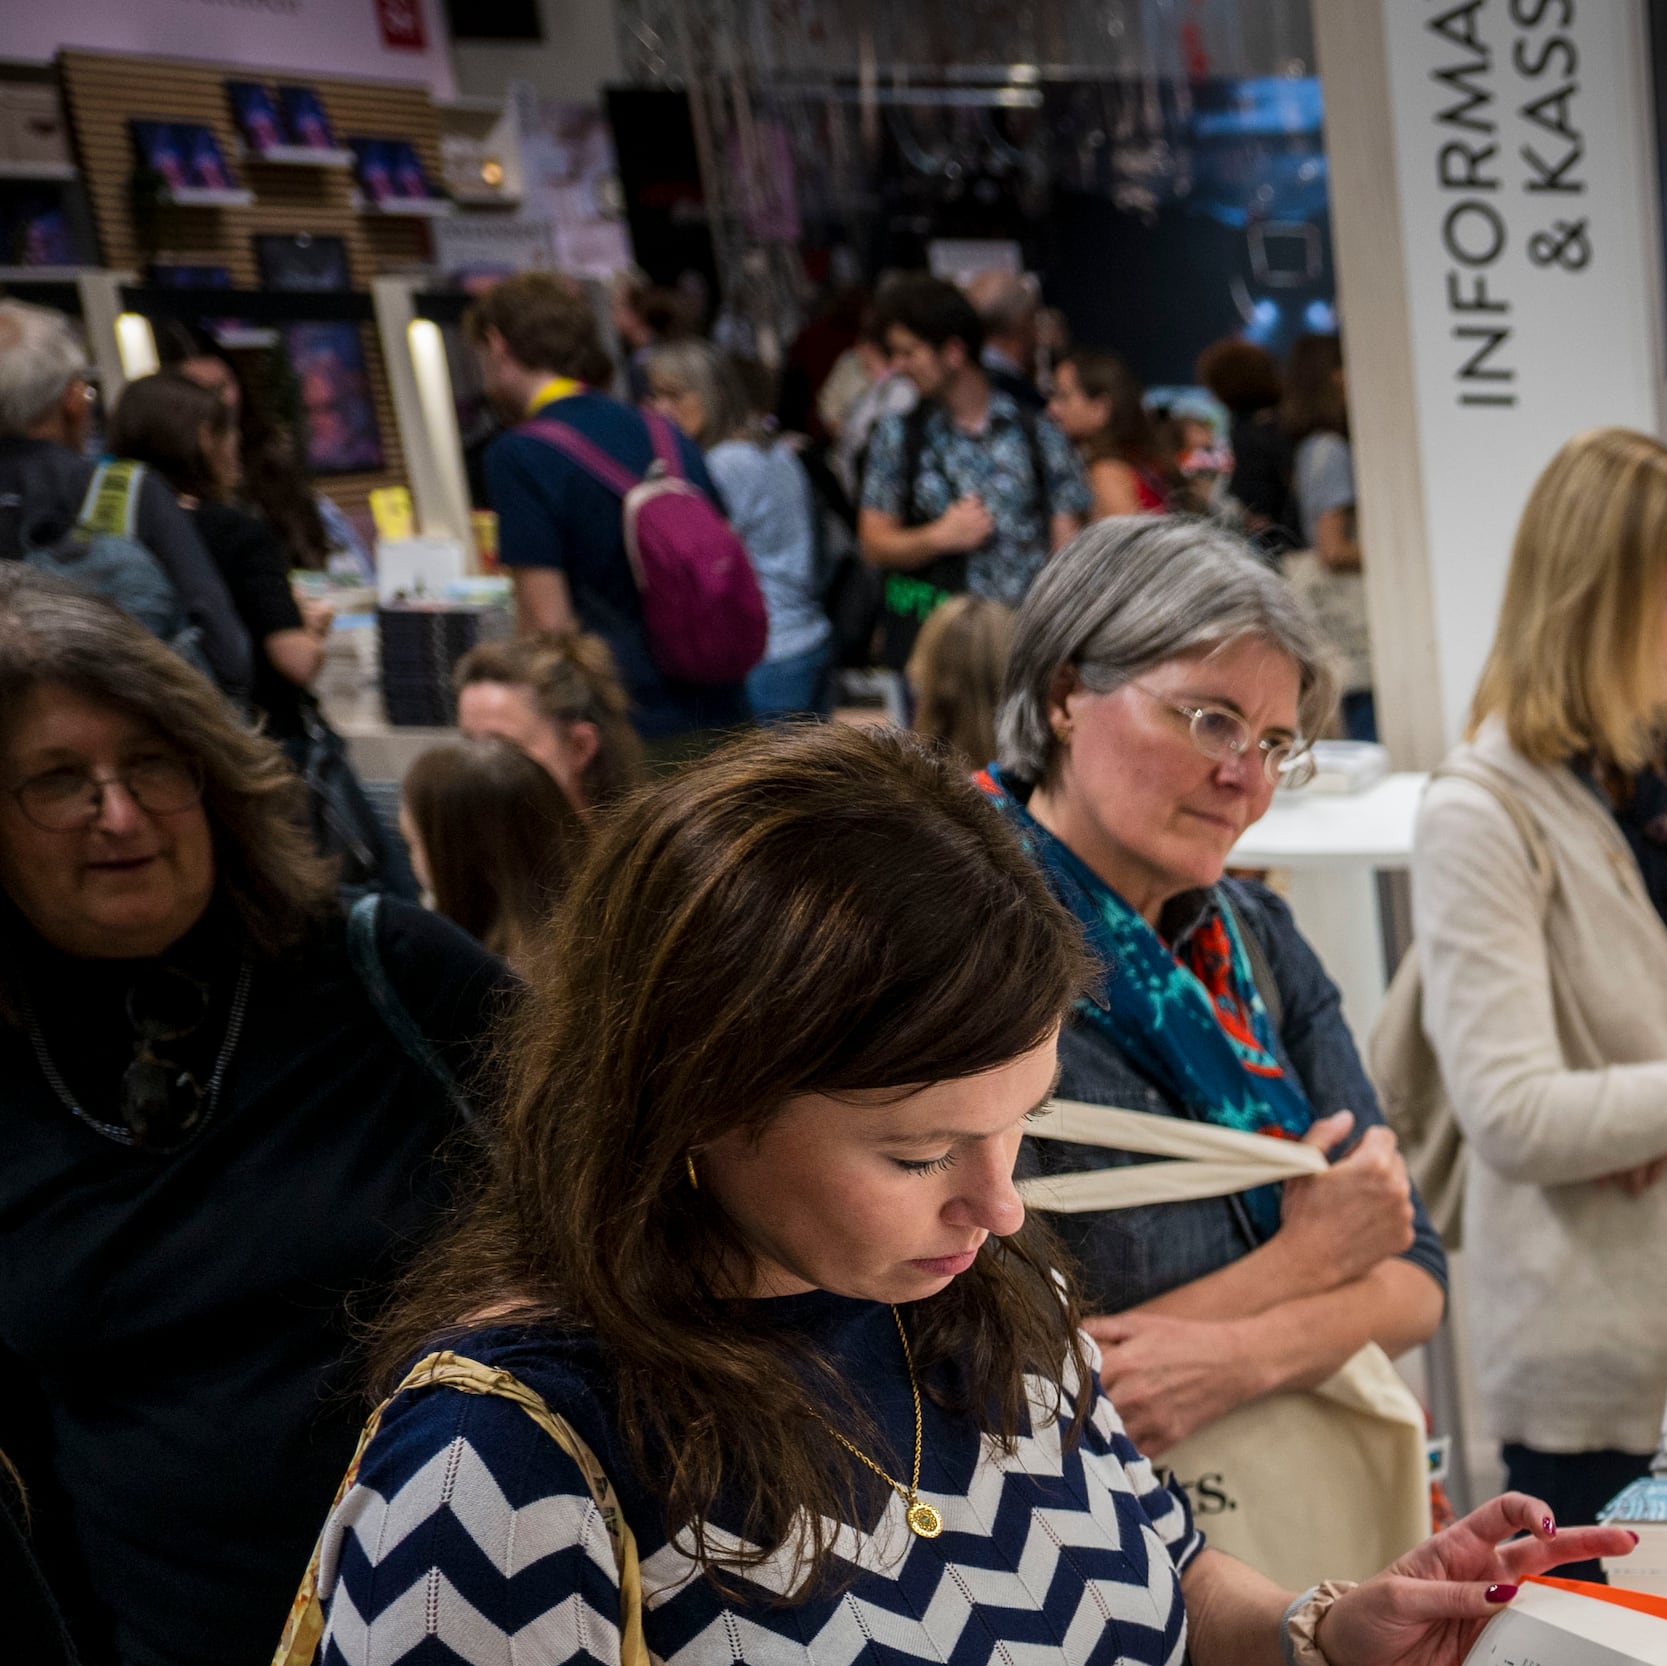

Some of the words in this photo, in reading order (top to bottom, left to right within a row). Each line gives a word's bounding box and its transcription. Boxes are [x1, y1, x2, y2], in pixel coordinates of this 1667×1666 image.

[1510, 0, 1586, 193] KASS
[1424, 0, 1518, 407] INFORMA
[1528, 217, 1592, 271] &
